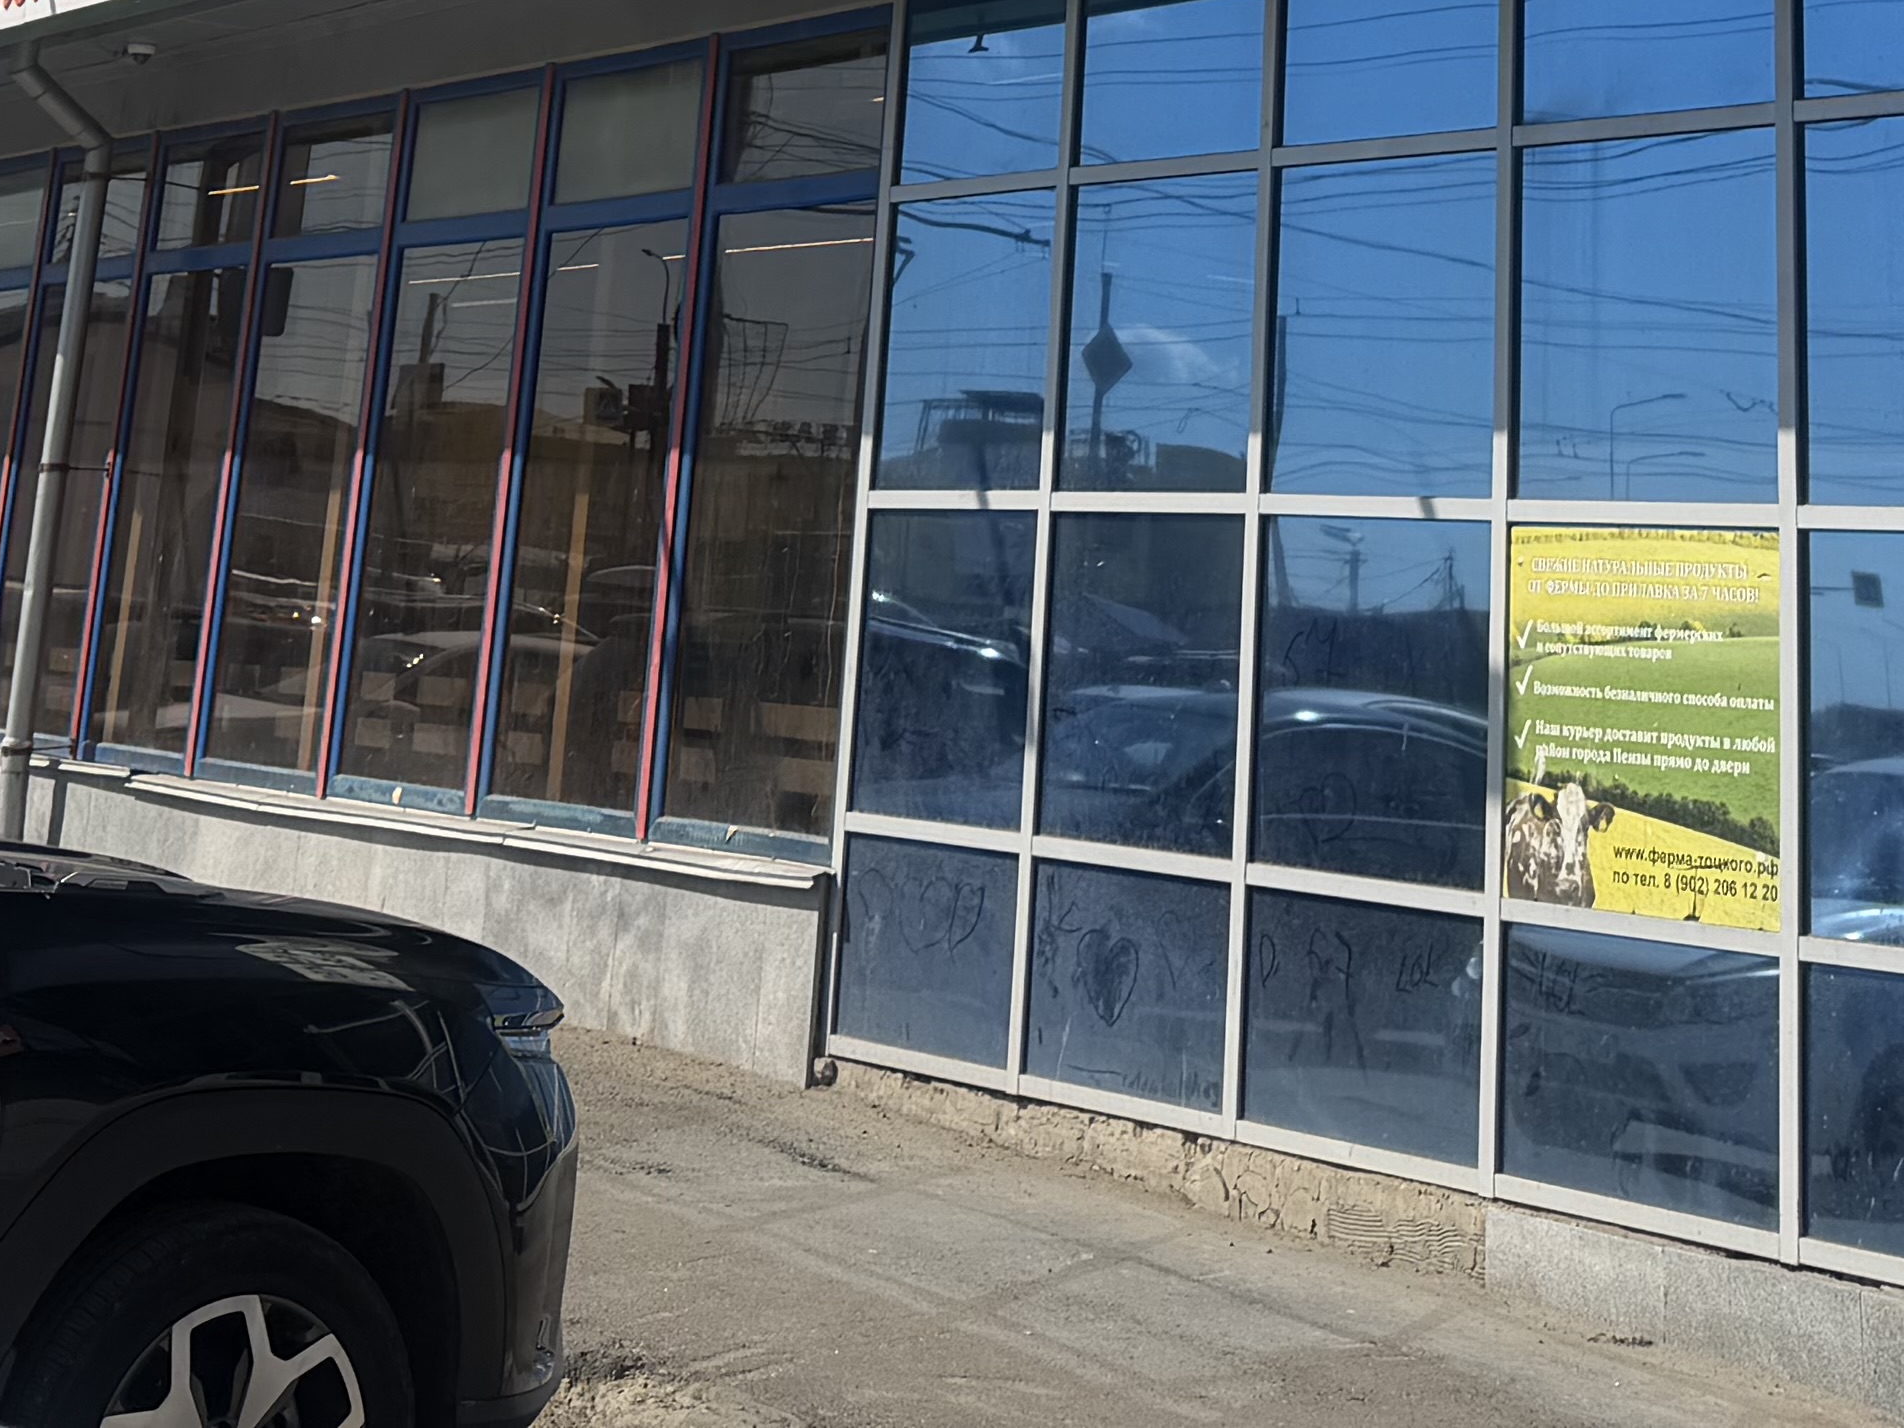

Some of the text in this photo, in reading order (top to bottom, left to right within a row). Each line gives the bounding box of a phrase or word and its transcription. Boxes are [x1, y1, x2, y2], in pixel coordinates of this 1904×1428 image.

[1531, 557, 1748, 581] СВЕЖИЕ НАТУРАЛЬНЫЕ ПРОДУКТЫ
[1547, 579, 1590, 595] ФЕРМЫ
[1592, 581, 1610, 598] ДО
[1612, 582, 1679, 599] ПРИЛАВКА
[1682, 584, 1698, 600] ЗА
[1712, 585, 1760, 603] ЧАСОВ!
[1536, 619, 1724, 644] Большой ассортимент фермерских
[1628, 645, 1673, 662] товаров
[1533, 680, 1775, 711] Возможность безналичного способа оплаты
[1535, 719, 1776, 753] Наш курьер доставит продукты в любой
[1536, 744, 1750, 776] район города Пензы прямо до двери
[1612, 871, 1779, 902] по тел. 8 (902) 206 12 20
